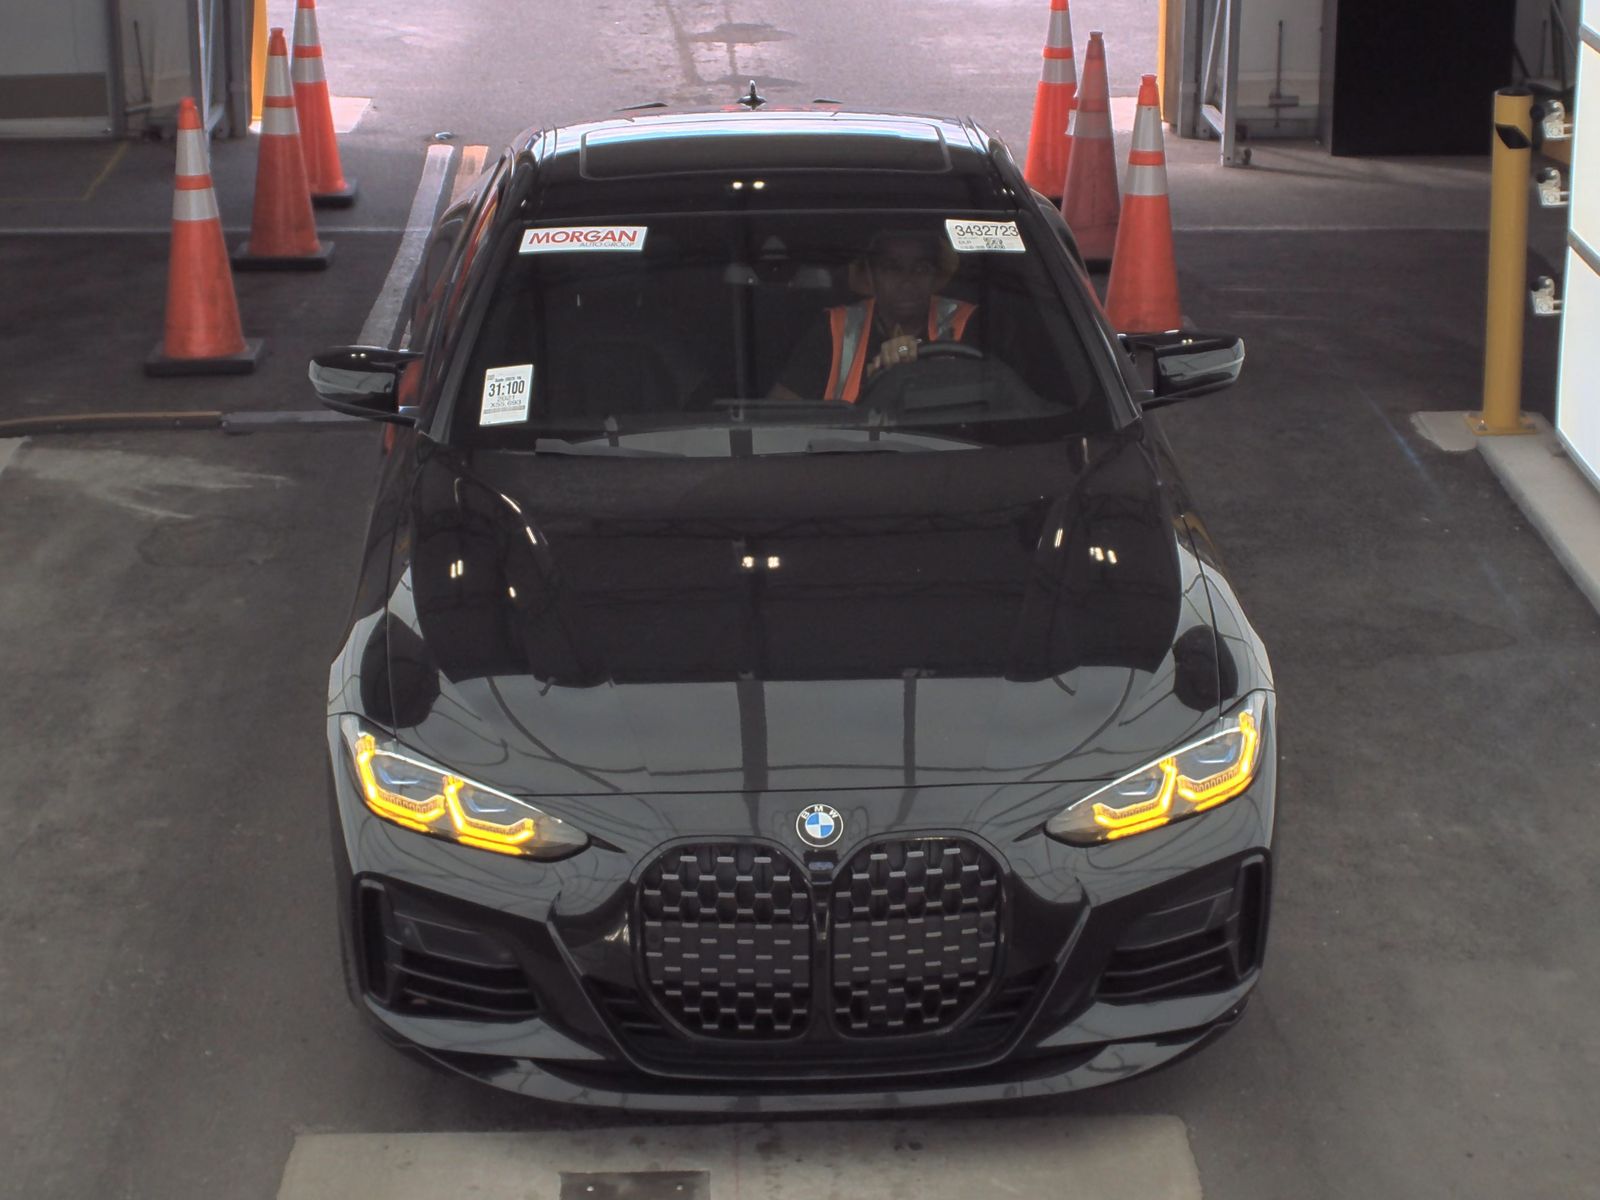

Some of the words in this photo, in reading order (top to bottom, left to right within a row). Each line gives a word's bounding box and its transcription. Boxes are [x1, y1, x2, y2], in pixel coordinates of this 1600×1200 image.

[529, 230, 637, 244] MORGAN
[955, 225, 1019, 237] 3432723
[488, 380, 525, 397] 31:100
[801, 805, 839, 819] BMW
